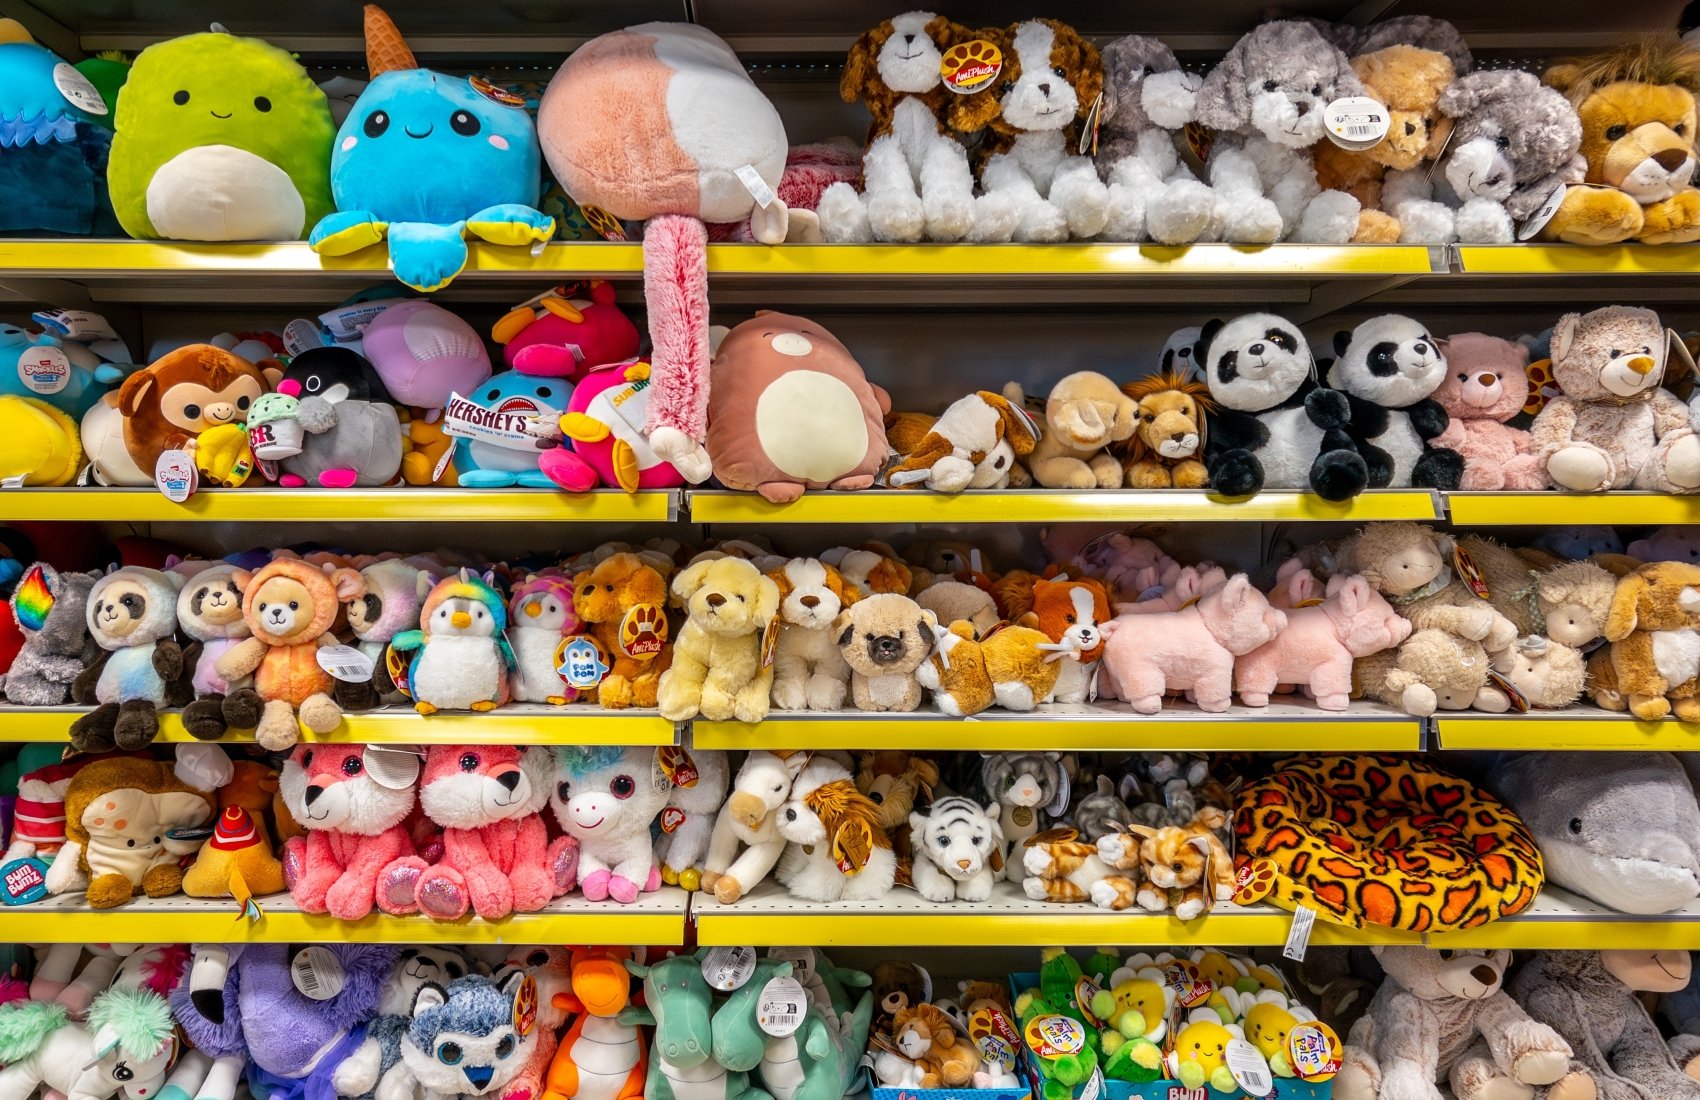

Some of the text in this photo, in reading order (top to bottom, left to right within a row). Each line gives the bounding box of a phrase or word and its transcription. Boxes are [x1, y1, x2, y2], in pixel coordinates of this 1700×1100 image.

[955, 64, 996, 84] AmiPlush
[446, 398, 528, 435] HERSHEY'S
[468, 424, 493, 435] cookies
[631, 640, 662, 656] AmiPlush
[1044, 1026, 1063, 1045] Pals
[1052, 1022, 1074, 1043] Palm
[983, 1041, 1009, 1060] Palm
[1295, 1037, 1309, 1063] Pals
[1307, 1034, 1321, 1064] Palm
